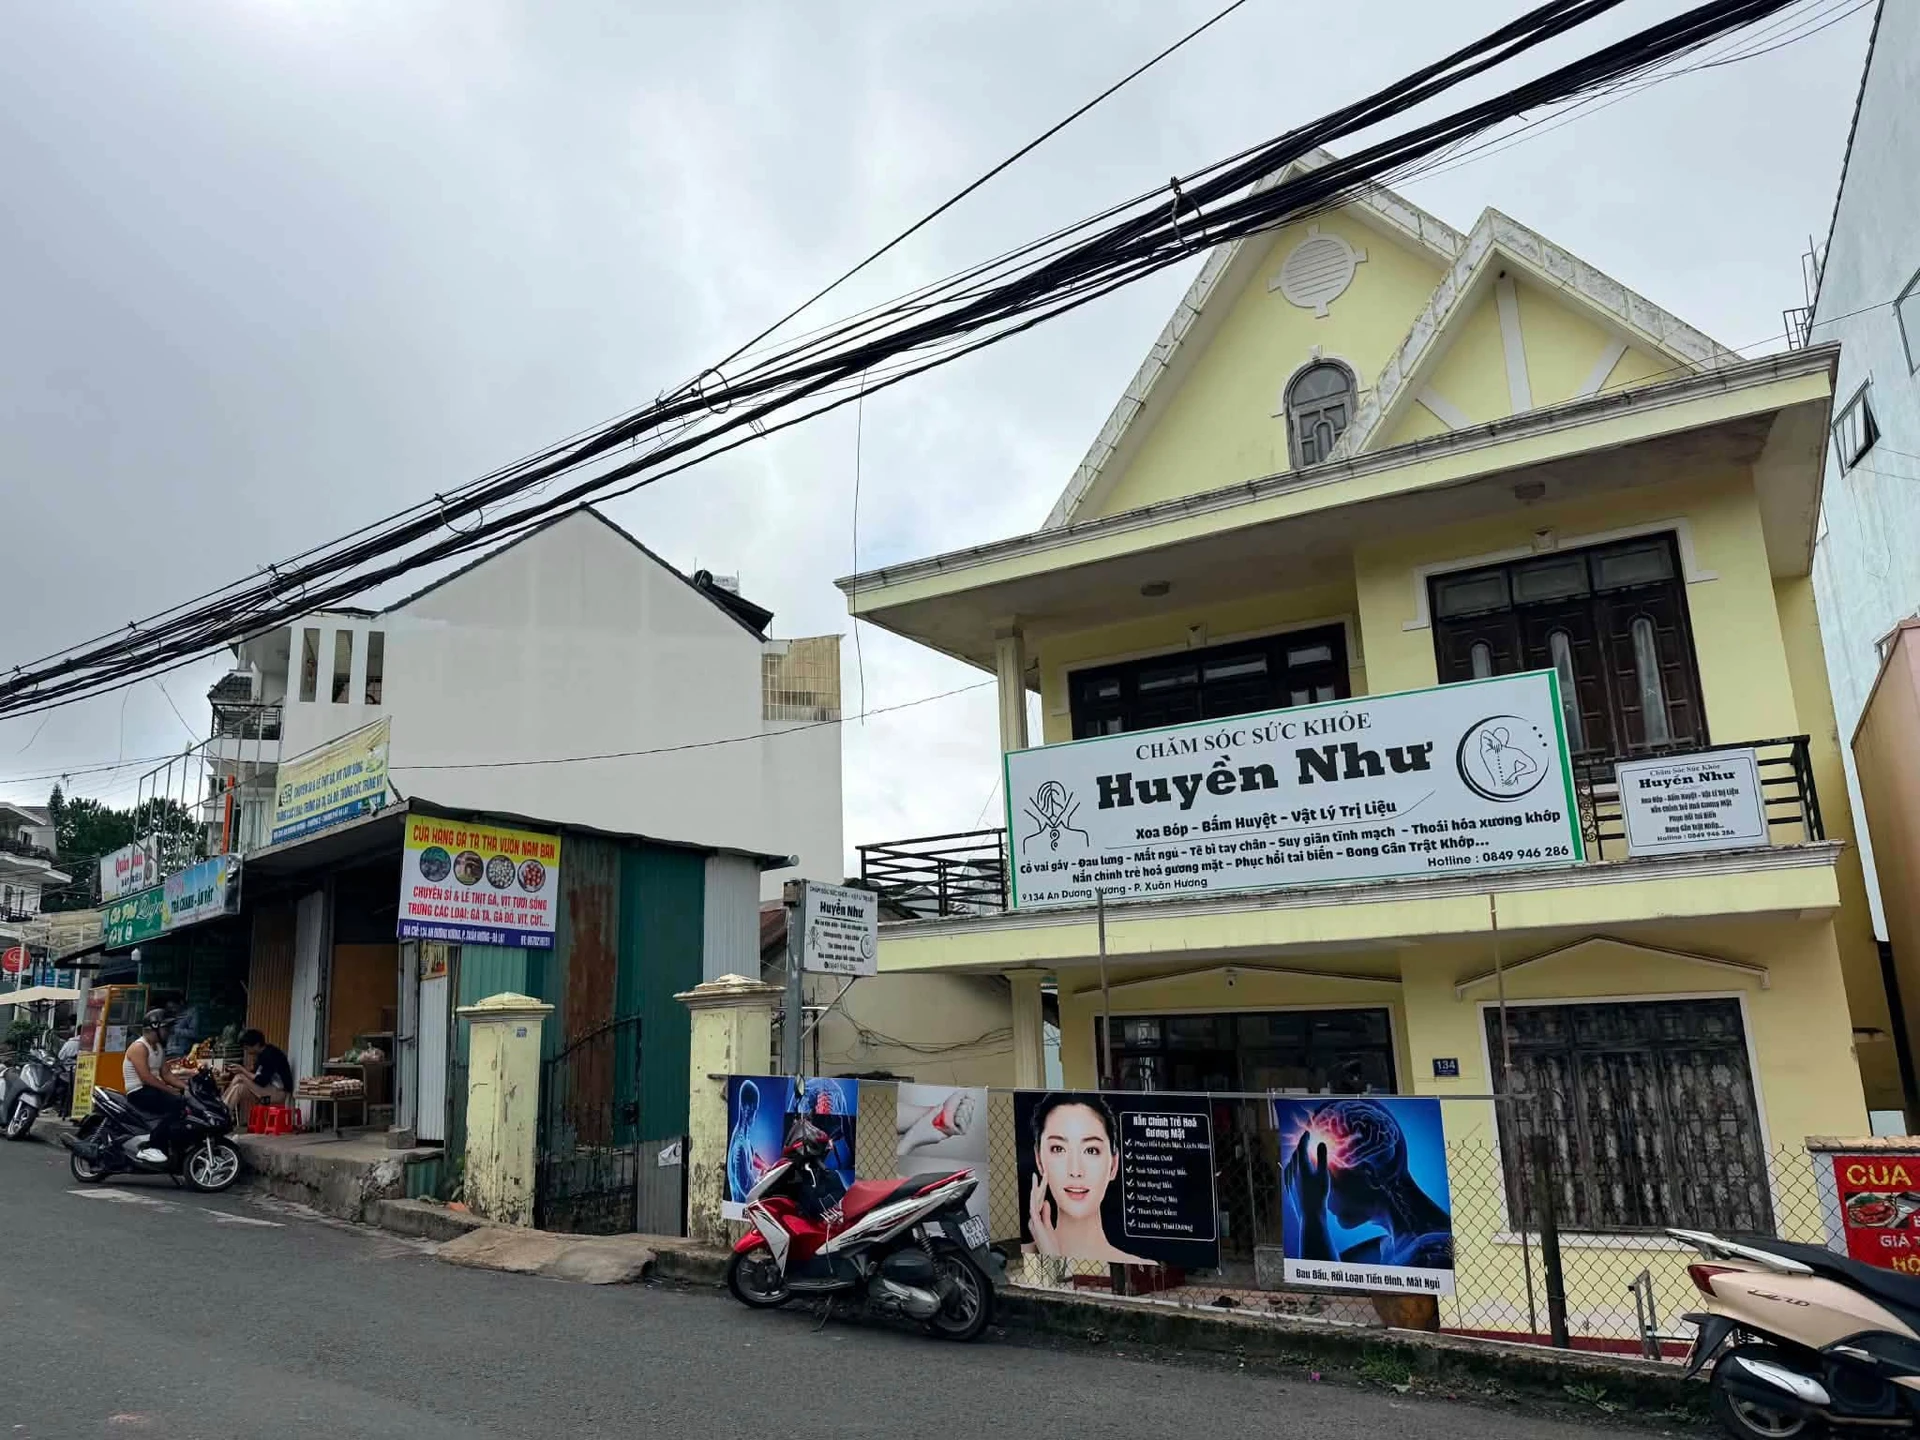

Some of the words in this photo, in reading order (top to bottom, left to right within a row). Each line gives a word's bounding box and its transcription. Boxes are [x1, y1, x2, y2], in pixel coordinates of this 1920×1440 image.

[1136, 736, 1198, 760] CHĂM
[1204, 729, 1246, 750] SÓC
[1252, 722, 1297, 744] SỨC
[1304, 711, 1372, 737] KHỎE
[1096, 755, 1279, 810] Huyền
[1295, 741, 1433, 785] Như
[1699, 771, 1736, 782] Như
[1136, 828, 1160, 840] Xoa
[1163, 823, 1188, 837] Bóp
[1202, 814, 1232, 832] Bấm
[1235, 813, 1277, 829] Huyệt
[1291, 808, 1317, 824] Vật
[1320, 805, 1336, 820] Lý
[1339, 803, 1361, 819] Trị
[1365, 800, 1397, 817] Liệu
[1034, 861, 1049, 872] vai
[1078, 858, 1100, 868] Đau
[1134, 847, 1156, 862] Mất
[1219, 844, 1236, 854] tay
[1240, 839, 1266, 851] chân
[1278, 837, 1300, 848] Suy
[1332, 830, 1358, 842] tĩnh
[1361, 827, 1395, 841] mạch
[1411, 820, 1448, 834] Thoái
[1451, 818, 1476, 831] hóa
[1479, 815, 1522, 828] xương
[1525, 810, 1560, 824] khớp
[1165, 863, 1198, 876] gương
[1201, 860, 1223, 873] mặt
[1235, 857, 1263, 869] Phục
[1266, 850, 1284, 864] hồi
[1287, 851, 1304, 863] tai
[1307, 845, 1333, 861] biến
[1346, 847, 1378, 857] Bong
[1381, 842, 1406, 854] Gân
[1408, 839, 1437, 853] Trật
[1428, 855, 1471, 867] Hotline
[1482, 851, 1513, 862] 0849
[1517, 848, 1541, 859] 946
[1545, 846, 1569, 857] 286
[1029, 893, 1044, 901] 134
[1047, 892, 1059, 900] An
[1174, 879, 1207, 889] Hương
[1880, 1233, 1911, 1247] GIÁ
